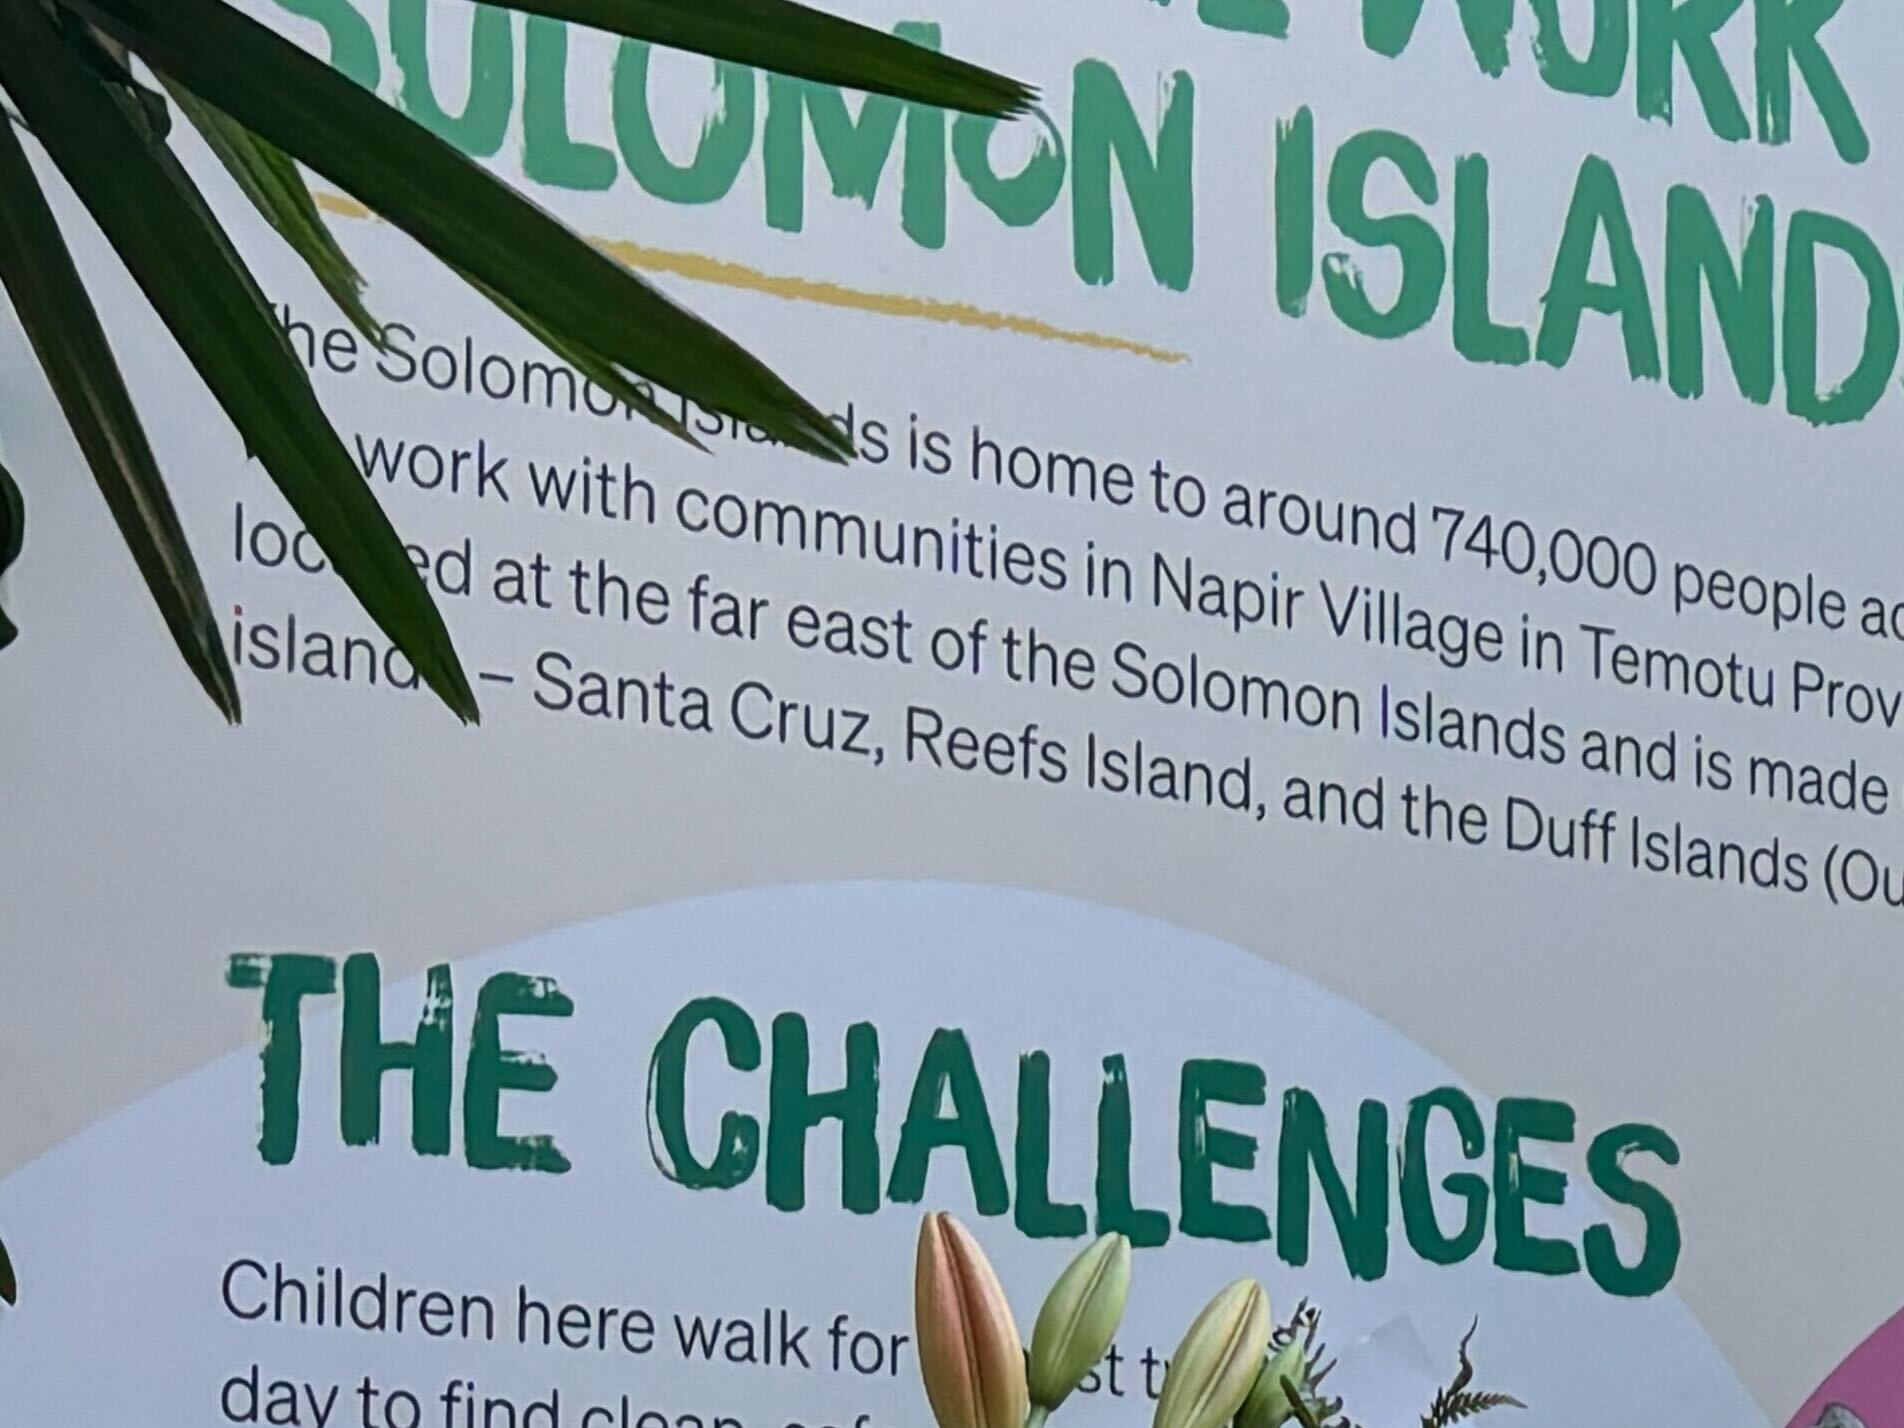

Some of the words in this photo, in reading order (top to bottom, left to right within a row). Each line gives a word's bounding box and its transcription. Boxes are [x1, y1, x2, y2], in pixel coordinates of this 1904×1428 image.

[268, 302, 358, 372] he
[909, 412, 952, 475] is
[972, 425, 1134, 506] home
[1149, 459, 1206, 519] to
[1223, 483, 1416, 555] around
[1432, 505, 1657, 596] 740,000
[1674, 562, 1847, 631] people
[355, 432, 510, 504] work
[528, 456, 655, 525] with
[676, 487, 1068, 591] communities
[1087, 540, 1132, 603] in
[1153, 552, 1305, 634] Napir
[1319, 579, 1504, 669] Village
[1521, 613, 1563, 674] in
[1579, 623, 1774, 708] Temotu
[232, 500, 472, 600] loced
[493, 552, 552, 609] at
[568, 558, 670, 626] the
[687, 573, 770, 641] far
[787, 604, 913, 664] east
[930, 618, 988, 675] of
[1001, 627, 1096, 691] the
[1111, 641, 1360, 734] Solomon
[1381, 683, 1566, 765] Islands
[1581, 730, 1676, 783] and
[1694, 734, 1733, 791] is
[1749, 756, 1889, 816] made
[232, 603, 420, 692] island
[533, 651, 713, 733] Santa
[730, 681, 884, 767] Cruz,
[906, 705, 1068, 784] Reefs
[1087, 732, 1266, 822] Island,
[1283, 776, 1384, 831] and
[1400, 783, 1488, 846] the
[1506, 795, 1617, 864] Duff
[1632, 815, 1809, 893] Islands
[223, 948, 576, 1176] THE
[645, 995, 1683, 1299] CHALLENGES
[222, 1258, 494, 1341] Children
[518, 1284, 655, 1355] here
[673, 1307, 810, 1369] walk
[827, 1314, 910, 1377] for
